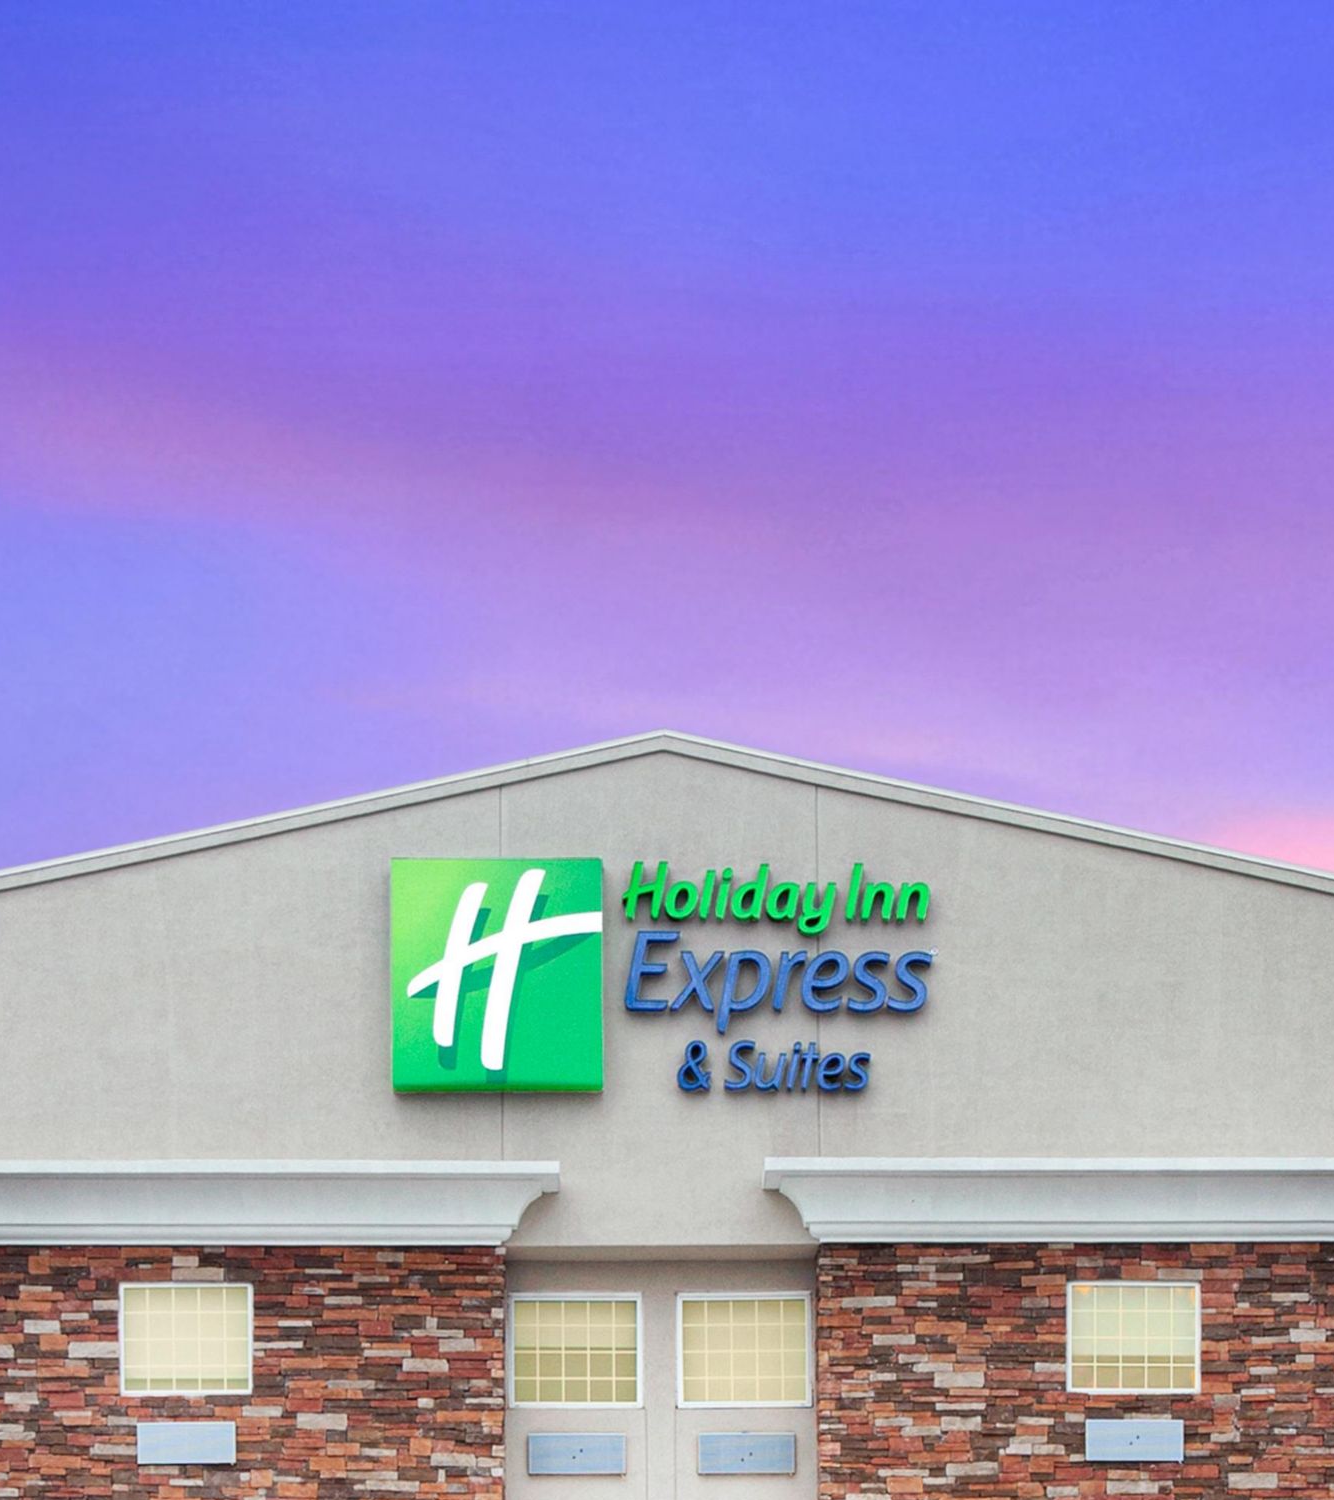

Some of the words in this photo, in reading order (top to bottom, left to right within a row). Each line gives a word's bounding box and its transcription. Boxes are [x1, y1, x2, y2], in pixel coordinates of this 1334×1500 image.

[622, 861, 836, 936] Holiday
[845, 862, 931, 923] Inn
[623, 930, 933, 1035] Express
[677, 1039, 710, 1092] &
[723, 1040, 872, 1093] Suites
